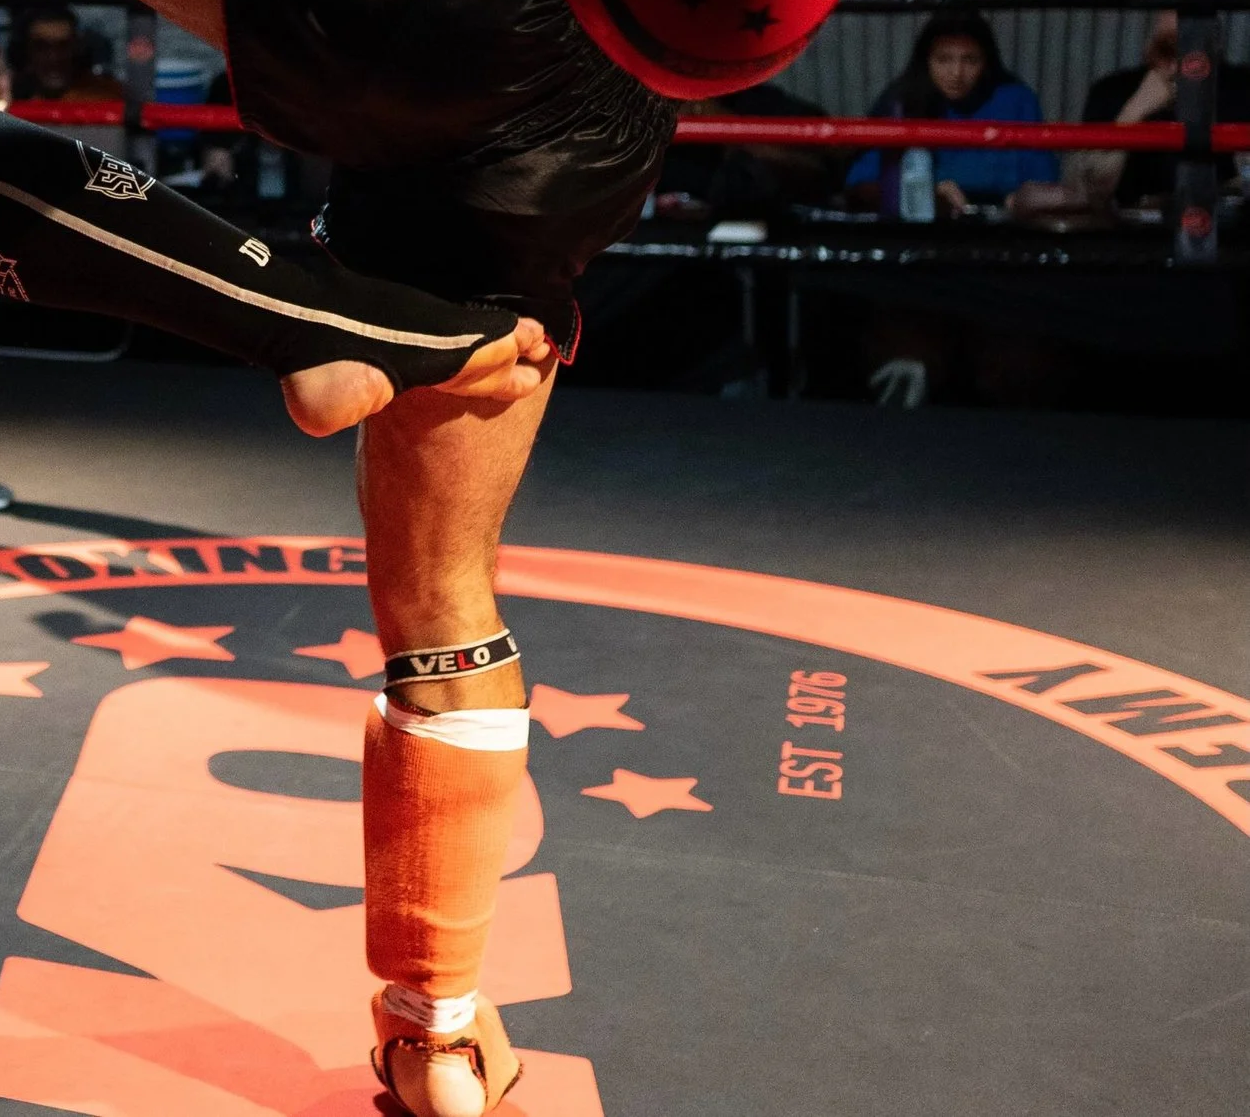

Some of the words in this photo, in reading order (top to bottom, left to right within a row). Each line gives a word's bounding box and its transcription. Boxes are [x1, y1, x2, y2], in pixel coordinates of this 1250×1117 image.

[410, 647, 490, 675] VELO
[786, 670, 848, 732] 1976
[778, 740, 844, 800] EST
